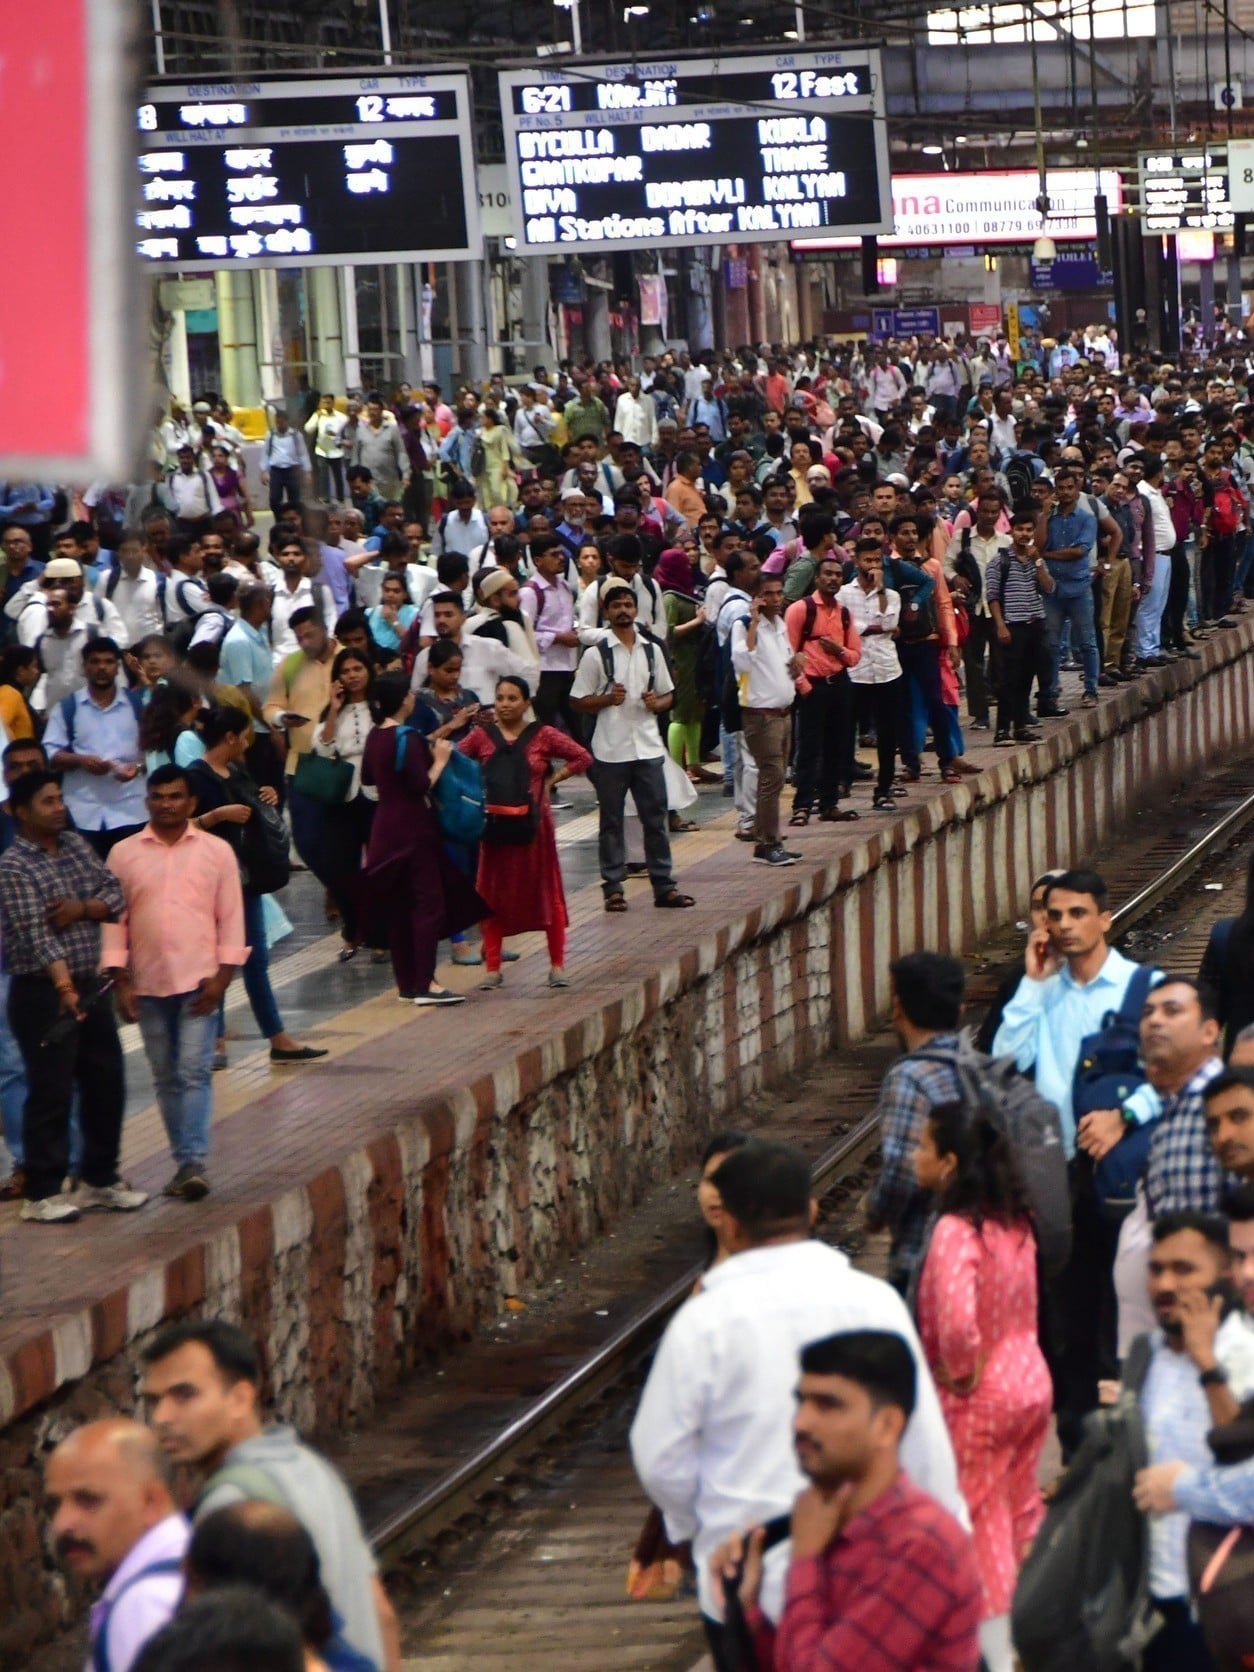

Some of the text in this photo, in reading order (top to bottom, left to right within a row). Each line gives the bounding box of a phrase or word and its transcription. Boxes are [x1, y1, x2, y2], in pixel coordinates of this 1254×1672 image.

[776, 53, 842, 67] CAR TYPE
[187, 83, 261, 97] DESTINATION
[400, 76, 427, 88] TYPE
[771, 71, 858, 99] 12 Fast
[356, 95, 385, 122] 12
[1220, 87, 1236, 105] 6
[519, 117, 533, 129] PF
[554, 115, 563, 126] 5
[584, 110, 644, 124] WILL HALT AT
[758, 116, 827, 145] KURLA
[518, 129, 614, 158] BYCULLA
[760, 144, 829, 173] THANE
[762, 172, 847, 202] KALYAN
[558, 213, 665, 242] Stations
[668, 209, 734, 235] After
[737, 202, 821, 232] KALYAN
